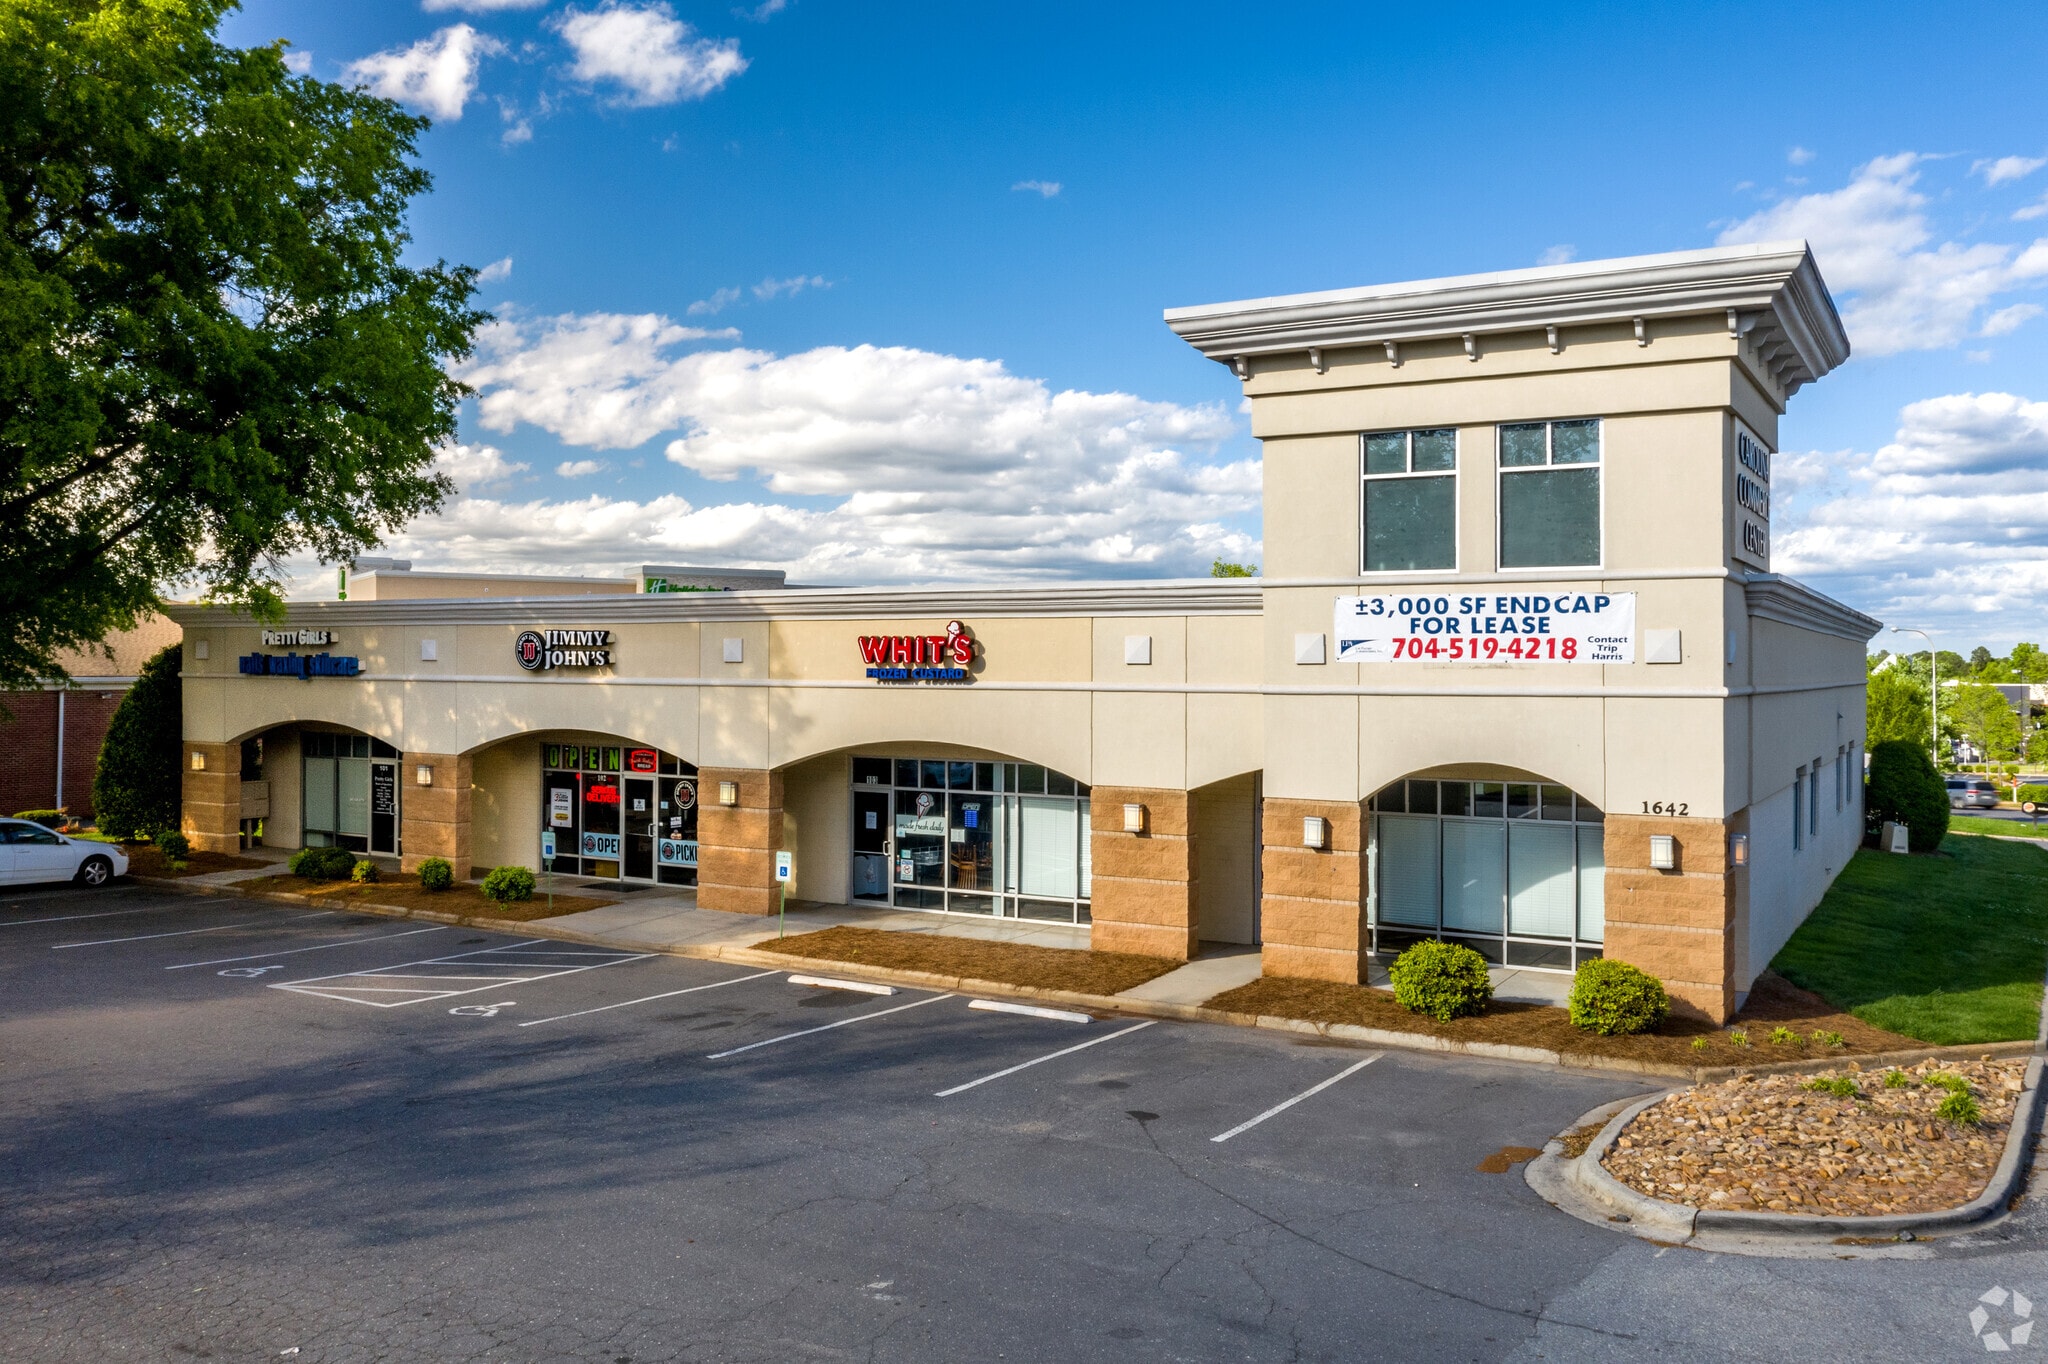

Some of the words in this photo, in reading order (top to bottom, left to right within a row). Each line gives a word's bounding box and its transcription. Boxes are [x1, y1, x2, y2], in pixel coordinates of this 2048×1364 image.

[1356, 597, 1449, 618] ±3,000
[1459, 597, 1487, 614] SF
[1410, 616, 1461, 634] FOR
[1471, 616, 1550, 634] LEASE
[262, 629, 299, 645] PRETTY
[545, 630, 605, 649] JIMMY
[858, 634, 972, 665] WHIT'S
[1392, 637, 1578, 659] 704-519-4218
[1597, 645, 1618, 653] Trip
[545, 651, 605, 670] JOHN'S
[866, 668, 908, 679] FROZEN
[912, 668, 964, 679] CUSTARD
[549, 747, 619, 770] OPEN
[1642, 801, 1689, 817] 1642
[930, 821, 945, 833] daily
